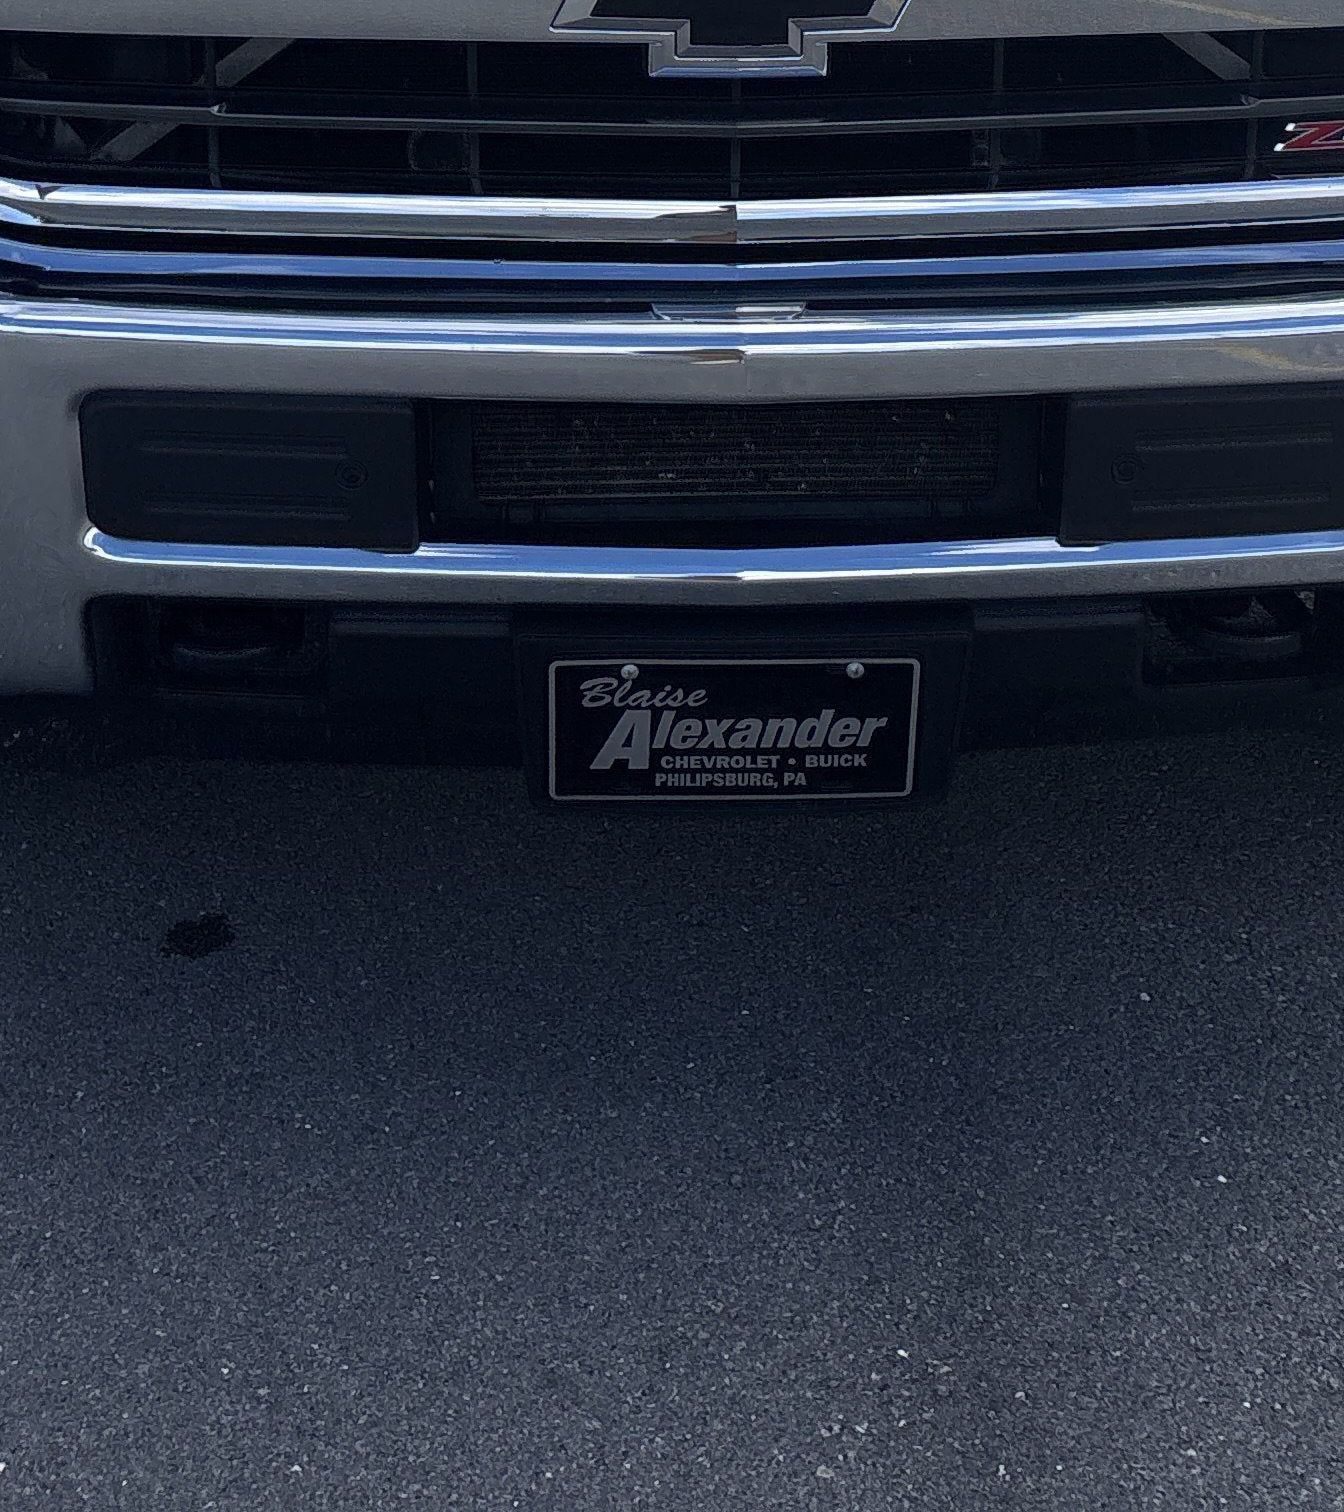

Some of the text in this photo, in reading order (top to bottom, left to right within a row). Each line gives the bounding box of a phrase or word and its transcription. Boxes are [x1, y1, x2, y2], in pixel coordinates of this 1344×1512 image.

[579, 677, 708, 708] Blaise
[589, 709, 888, 770] Alexander
[660, 753, 867, 769] CHEVROLET BUICK
[655, 772, 807, 788] PHILIPSBURG, PA
